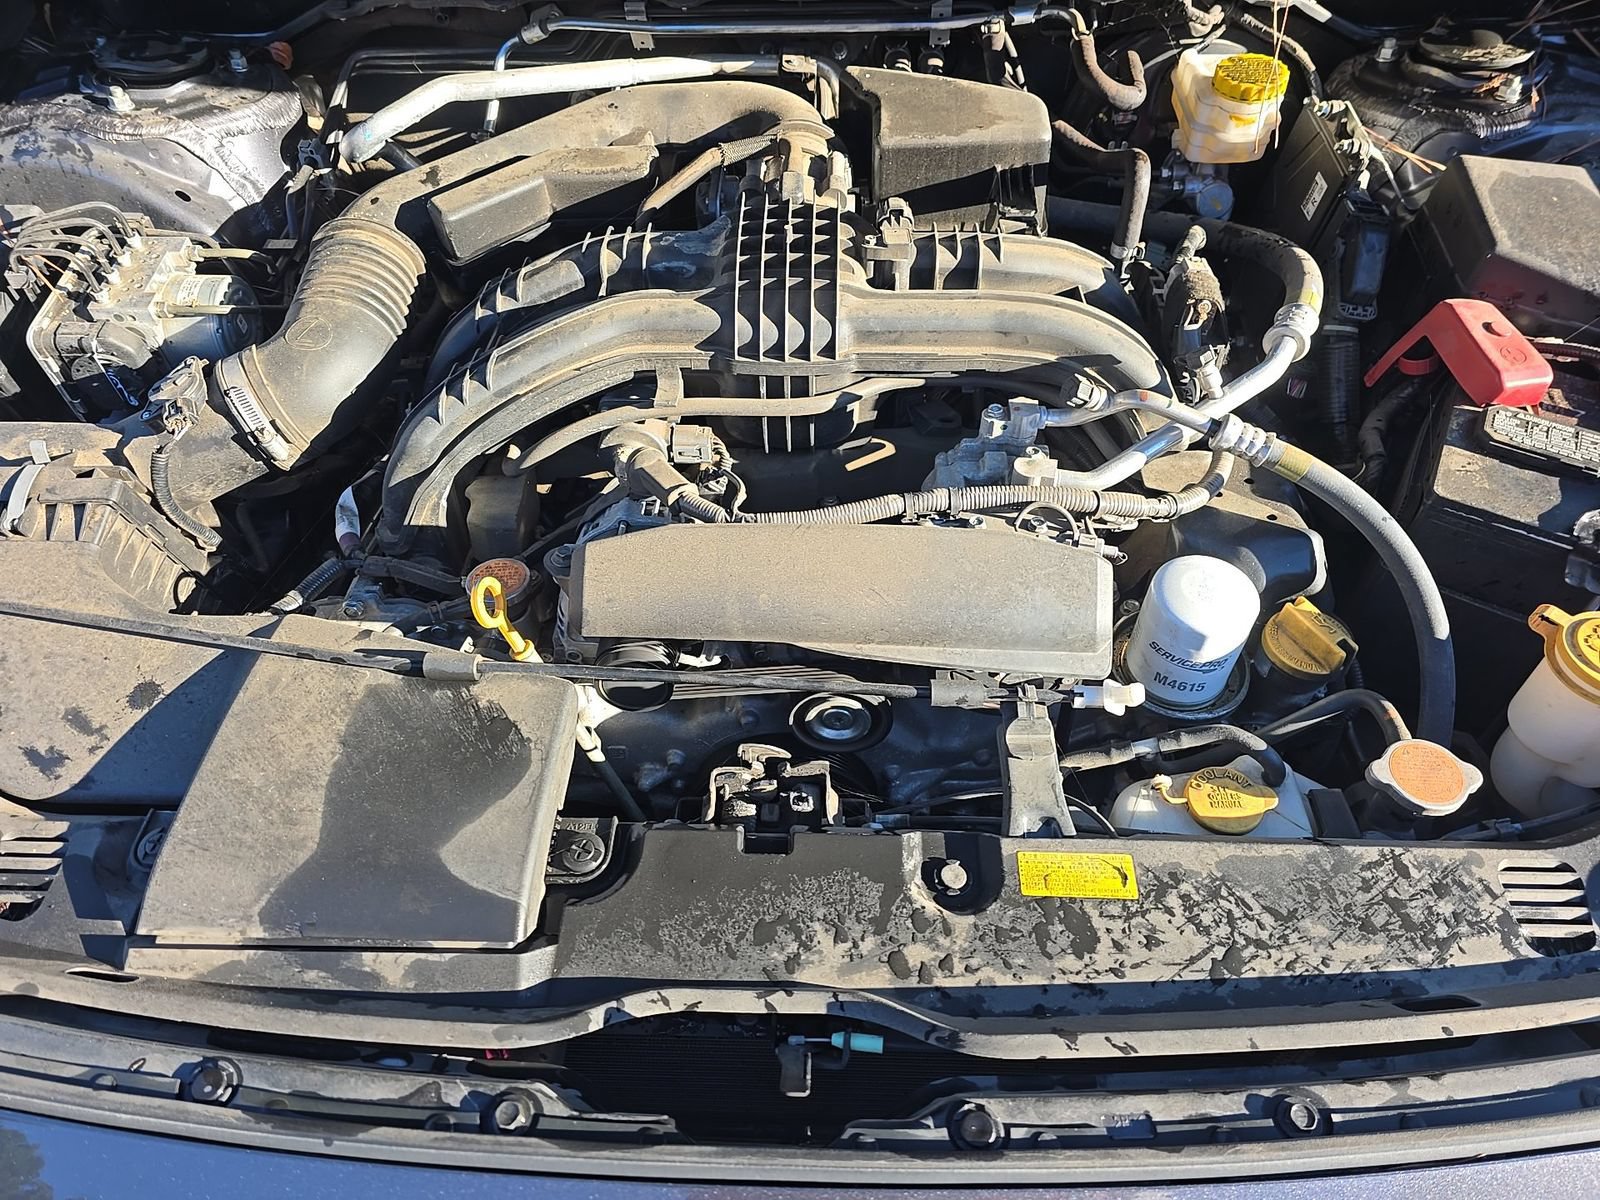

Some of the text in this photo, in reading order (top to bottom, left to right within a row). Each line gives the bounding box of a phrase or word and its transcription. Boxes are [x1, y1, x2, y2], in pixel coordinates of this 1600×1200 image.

[1149, 641, 1230, 669] SERVICEPRO
[1154, 672, 1206, 692] M4615
[1190, 769, 1253, 791] COOLANT
